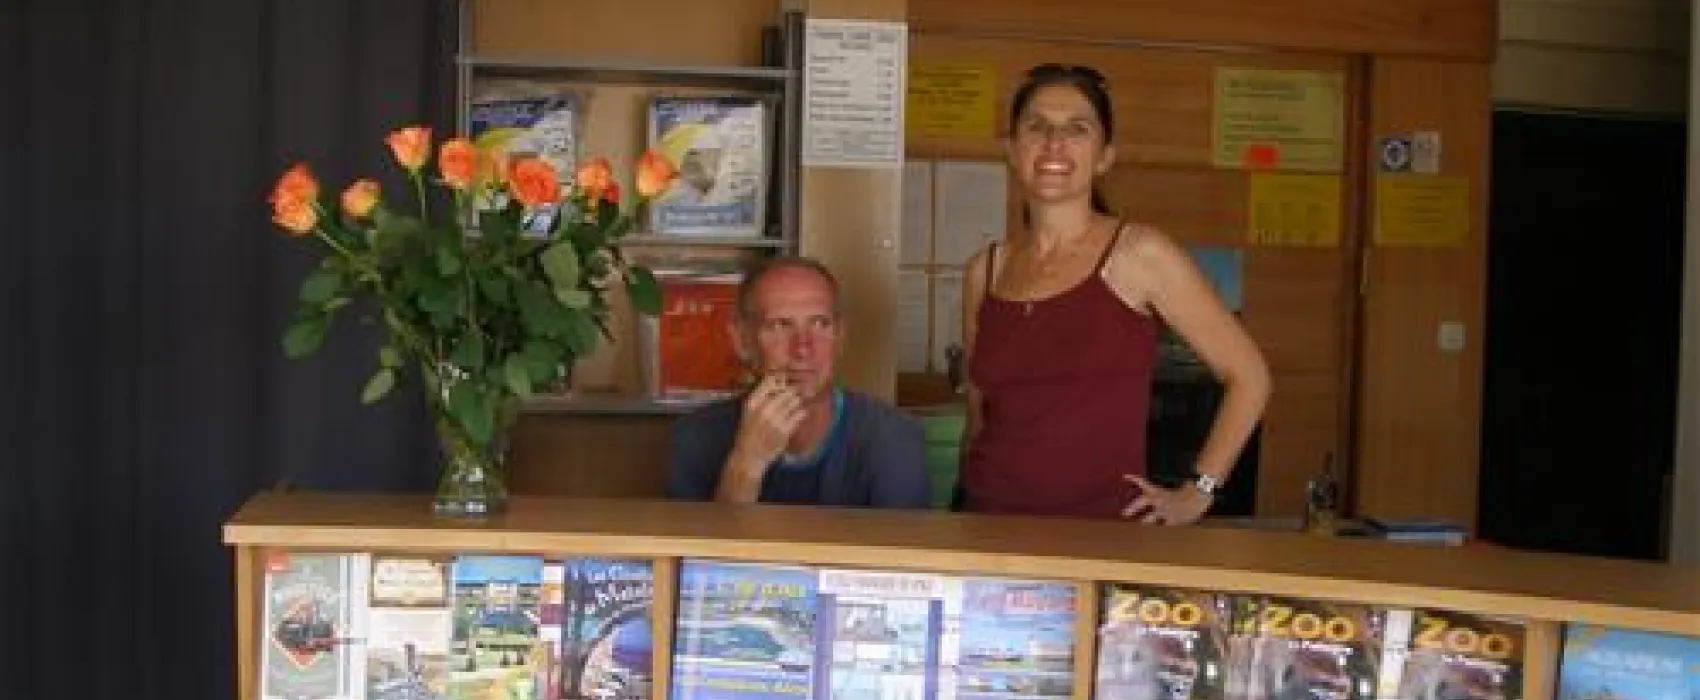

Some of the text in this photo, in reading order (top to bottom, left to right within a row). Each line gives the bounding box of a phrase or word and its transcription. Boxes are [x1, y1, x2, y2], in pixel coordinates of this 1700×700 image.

[1111, 589, 1202, 626] ZOO
[1265, 604, 1355, 641] ZOO
[1415, 616, 1513, 657] ZOO
